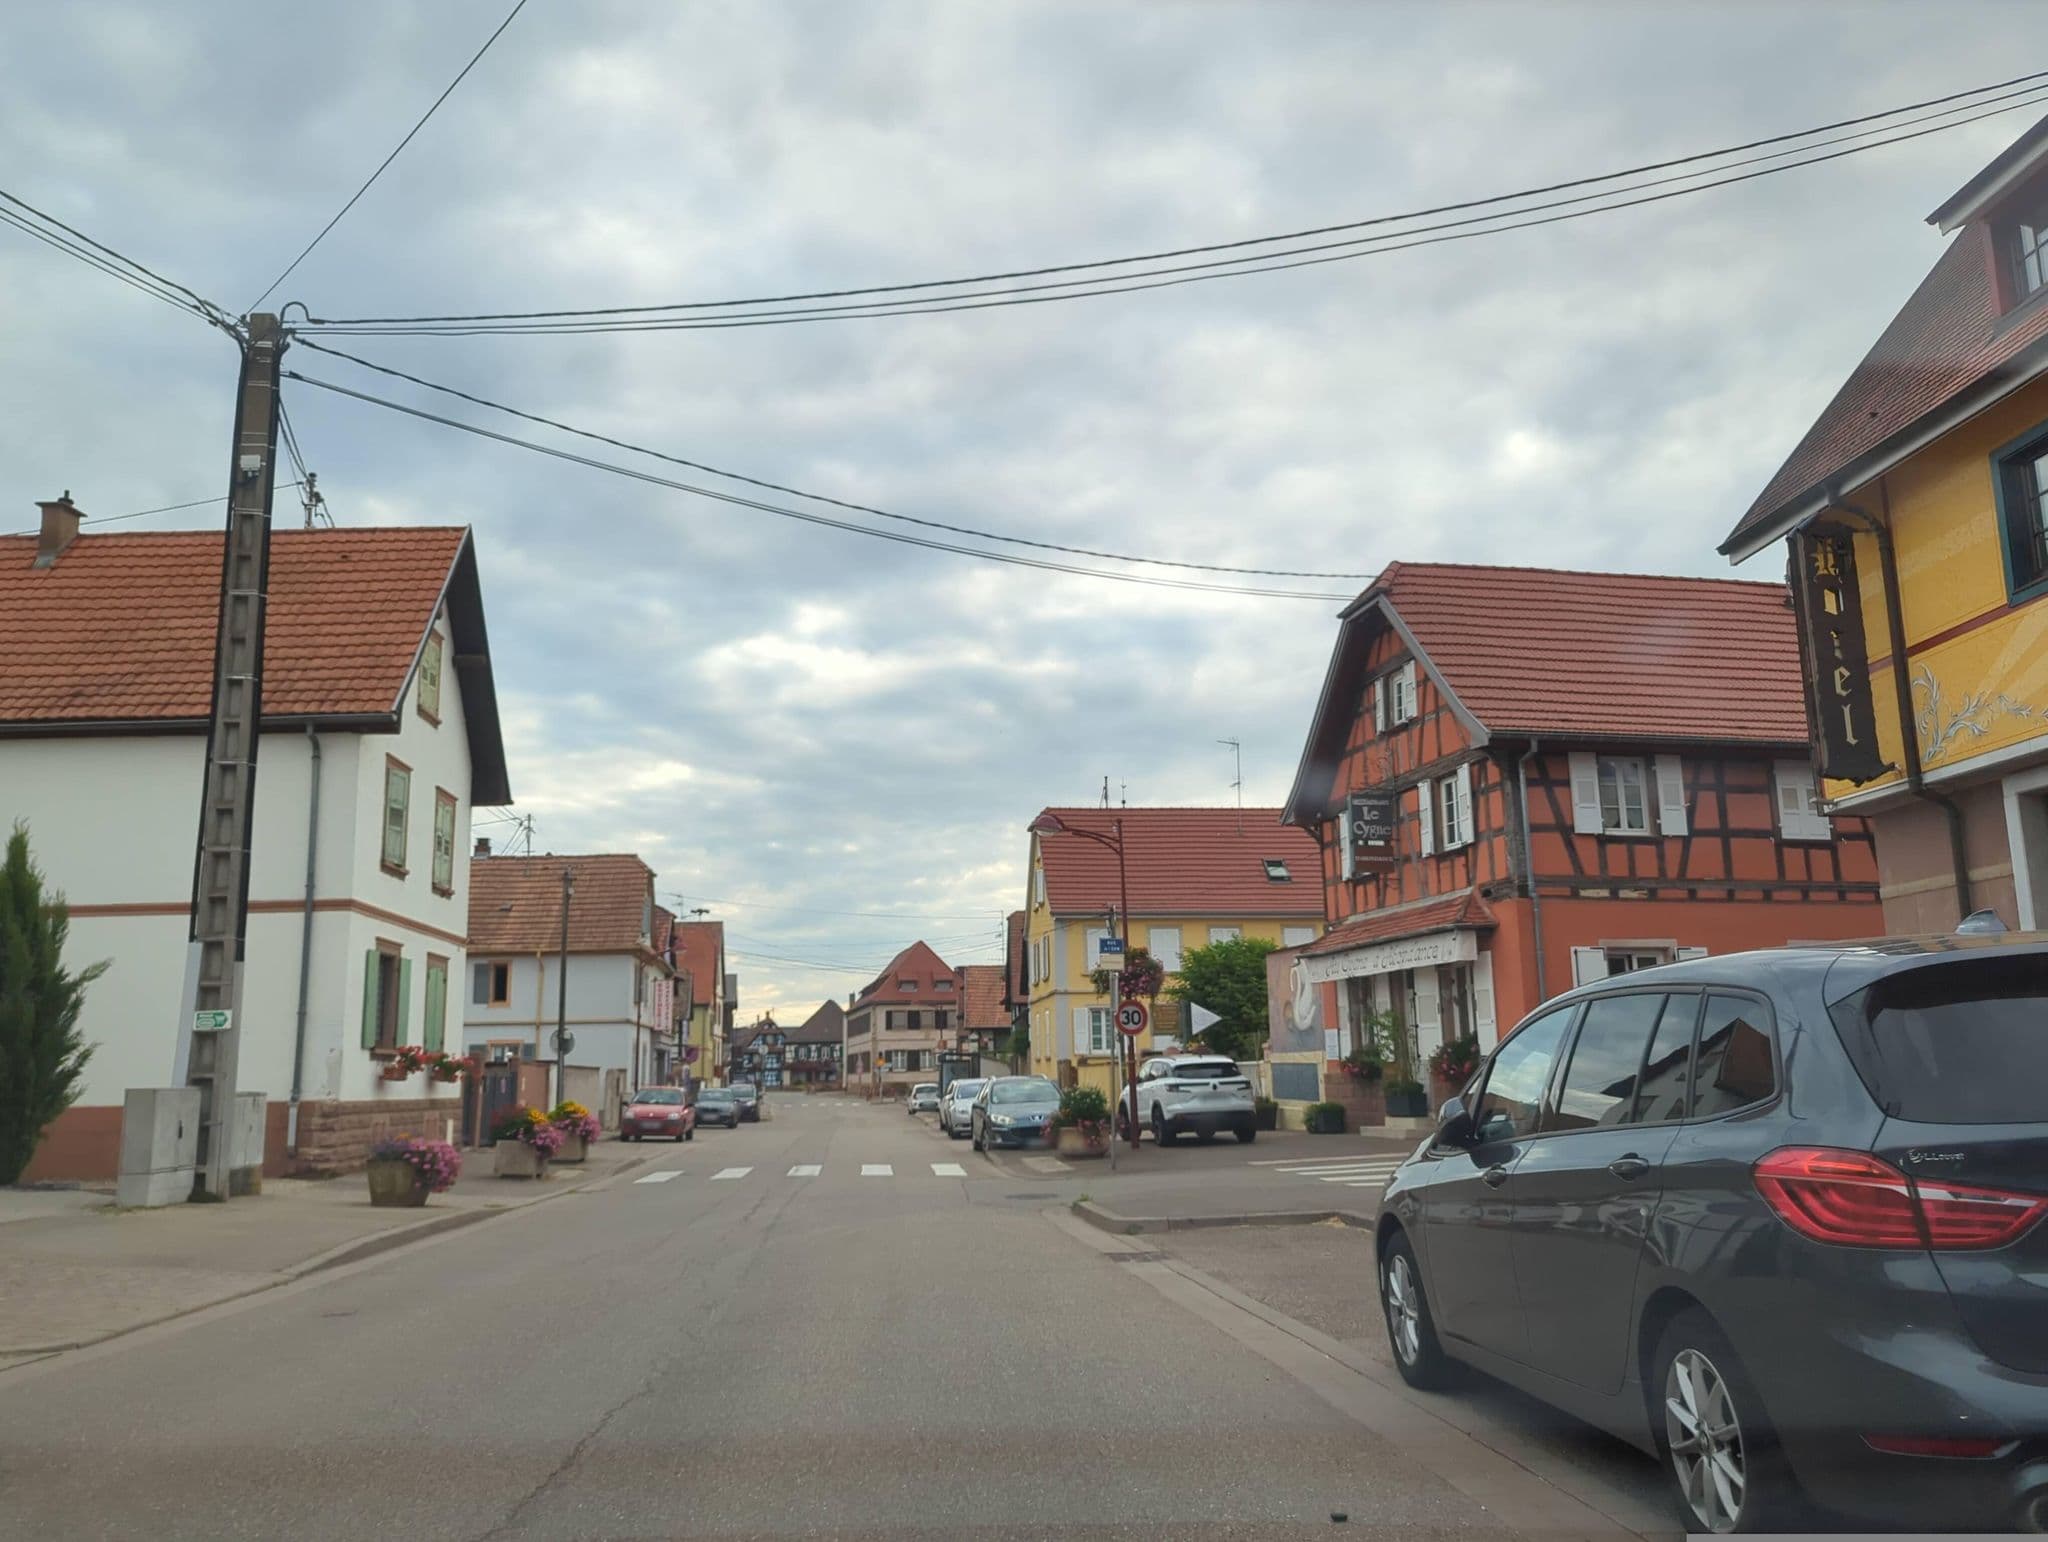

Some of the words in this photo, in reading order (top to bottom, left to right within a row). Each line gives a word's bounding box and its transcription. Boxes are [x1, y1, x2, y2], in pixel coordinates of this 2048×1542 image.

[1362, 806, 1379, 820] Le
[1353, 821, 1392, 838] Cygne
[1121, 1010, 1141, 1026] 30
